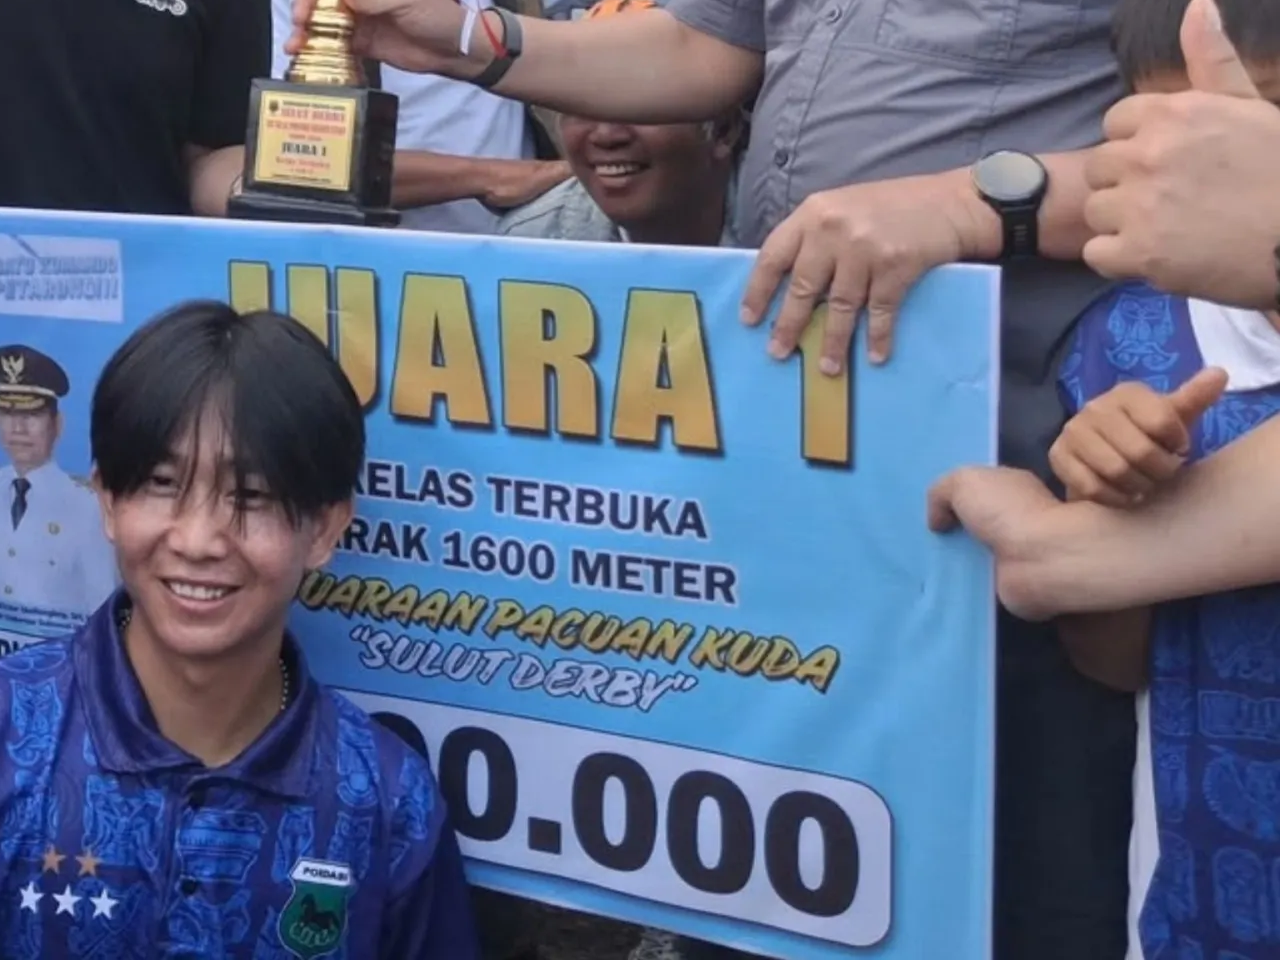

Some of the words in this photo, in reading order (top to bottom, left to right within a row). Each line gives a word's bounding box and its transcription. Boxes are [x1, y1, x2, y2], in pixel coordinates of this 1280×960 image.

[776, 302, 853, 466] 1
[335, 518, 430, 563] RAK
[442, 530, 556, 581] 1600
[571, 548, 737, 605] METER
[486, 476, 708, 540] TERBUKA
[298, 567, 488, 636] UARAAN
[483, 597, 697, 664] PACUAN
[688, 625, 841, 694] KUDA
[371, 711, 860, 918] 0.000
